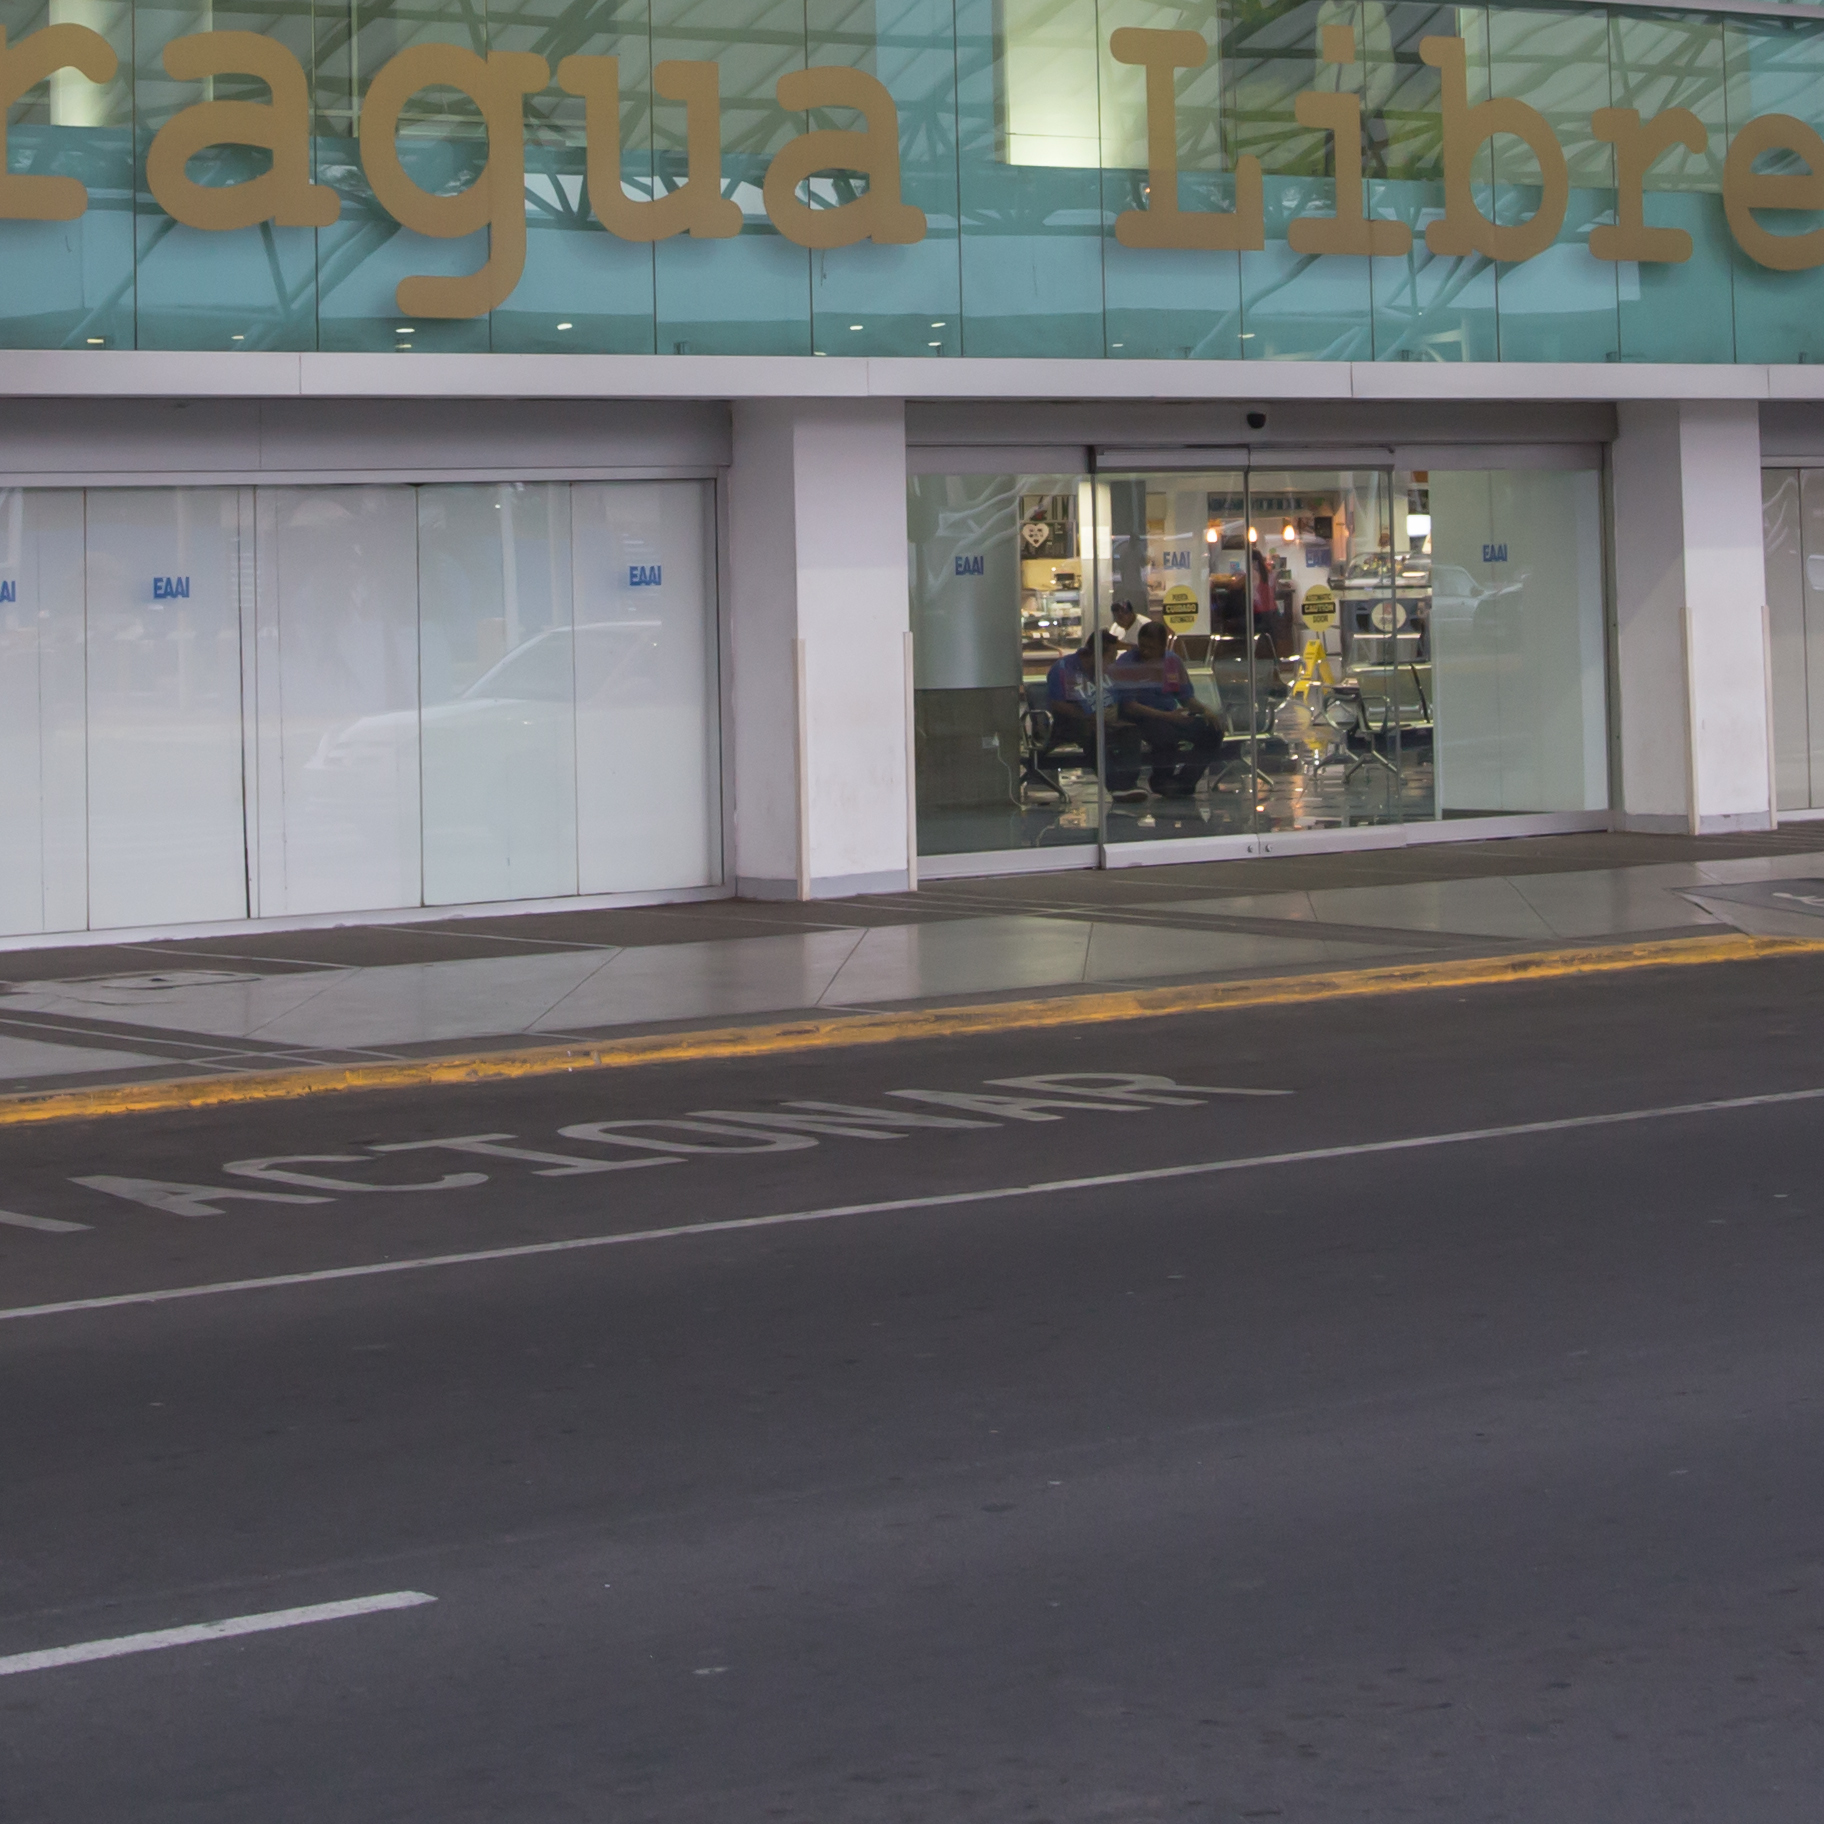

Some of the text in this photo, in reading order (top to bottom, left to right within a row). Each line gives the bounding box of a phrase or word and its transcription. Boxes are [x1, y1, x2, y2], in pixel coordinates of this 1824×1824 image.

[1483, 543, 1508, 562] EAAI
[629, 565, 662, 586] EAAI
[955, 555, 984, 576] EAAI
[153, 576, 190, 600] EAAI
